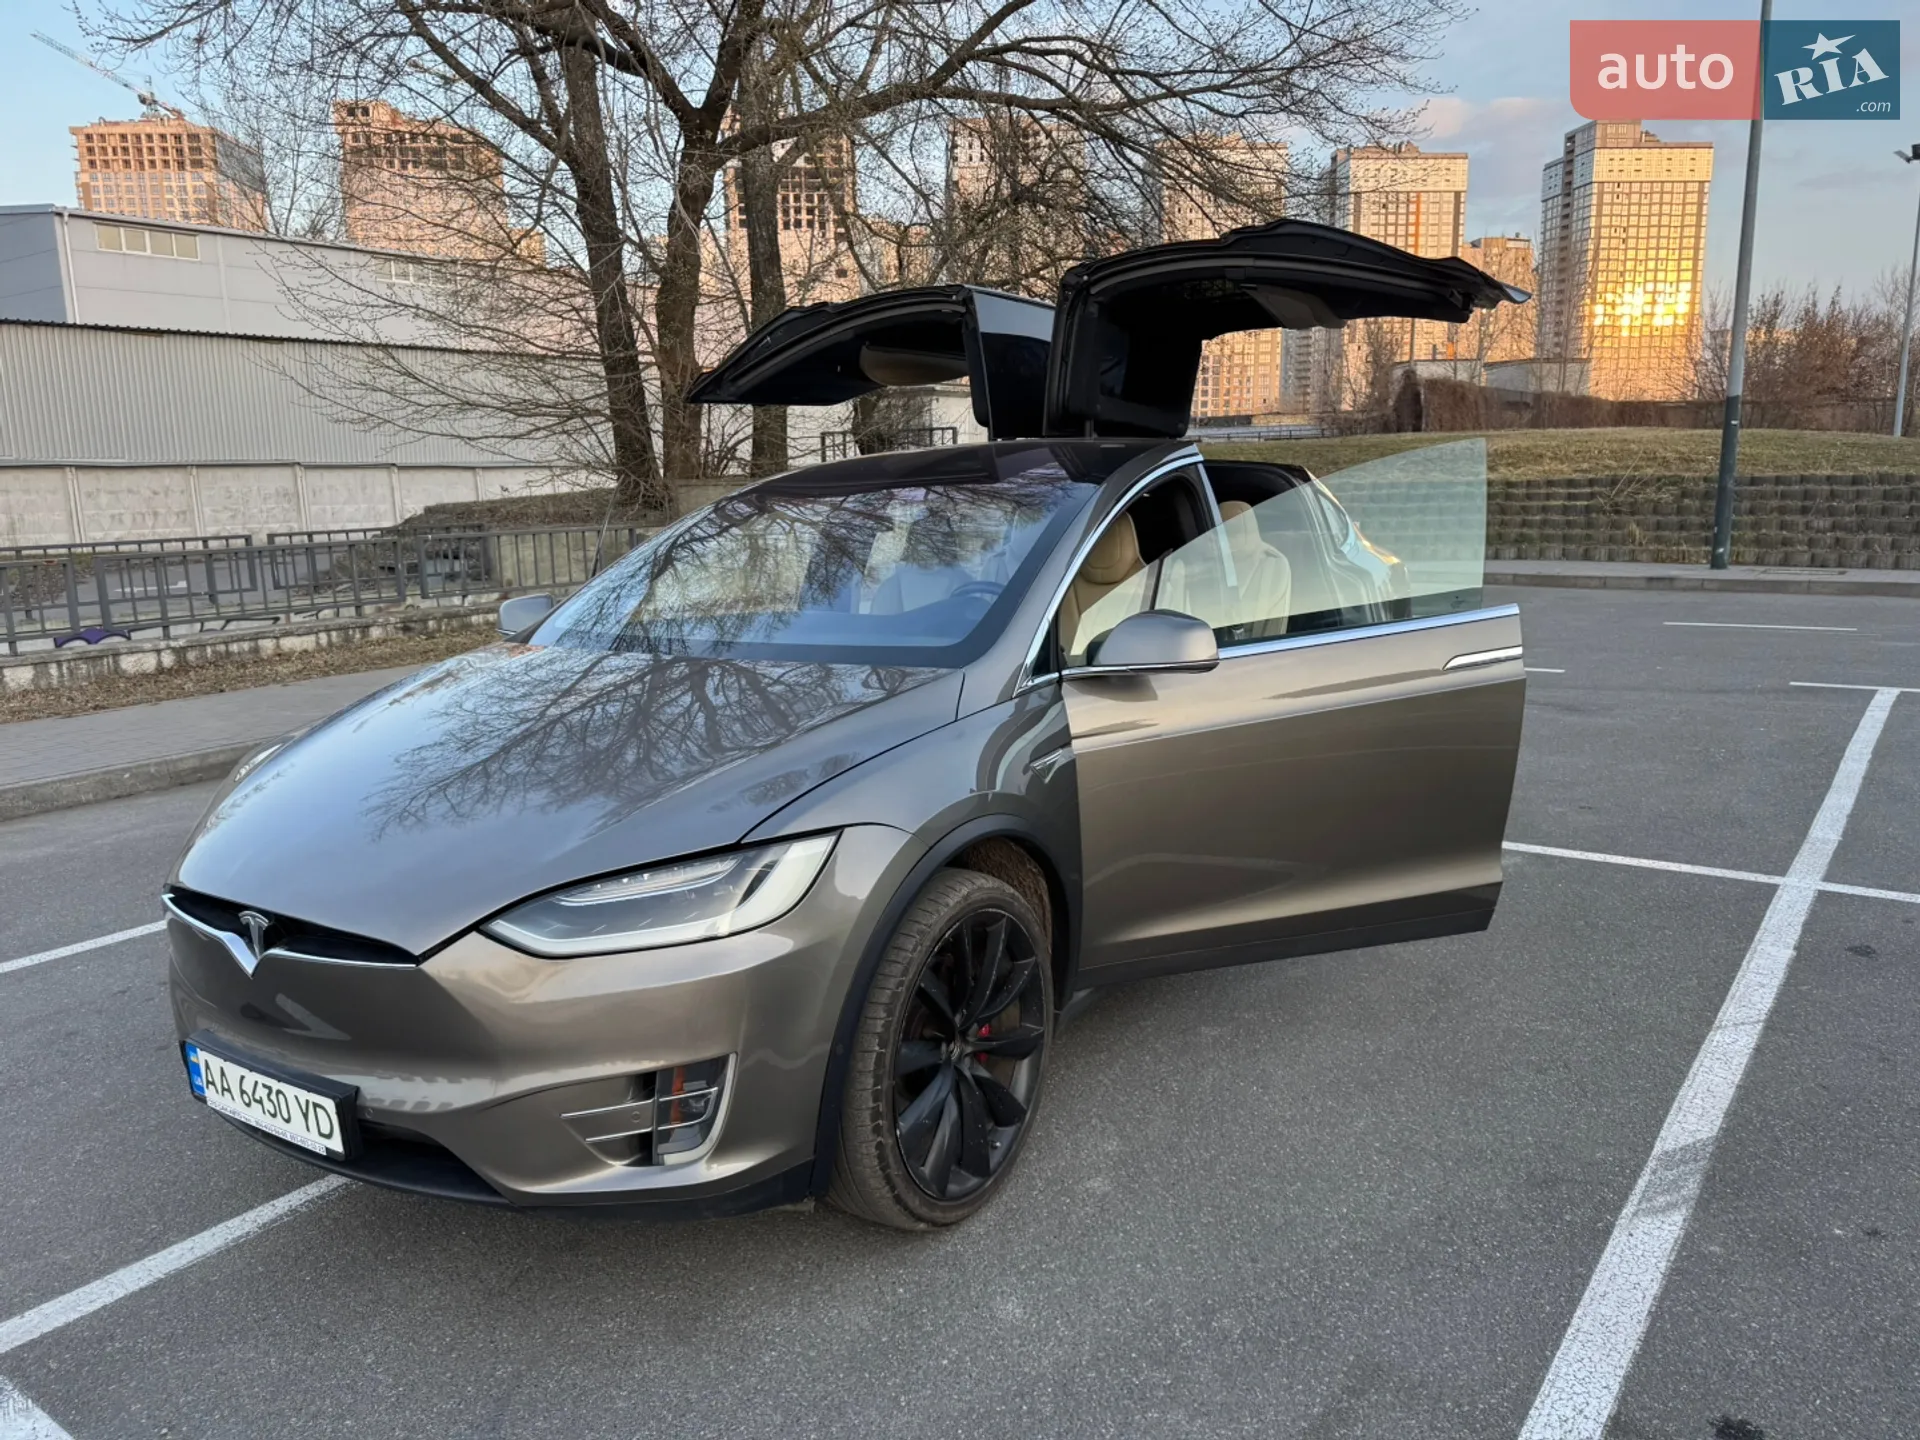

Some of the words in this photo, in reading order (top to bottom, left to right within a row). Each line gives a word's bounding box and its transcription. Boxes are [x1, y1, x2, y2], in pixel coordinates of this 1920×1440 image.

[204, 1058, 236, 1101] AA
[239, 1074, 292, 1124] 6430
[294, 1094, 335, 1140] YD
